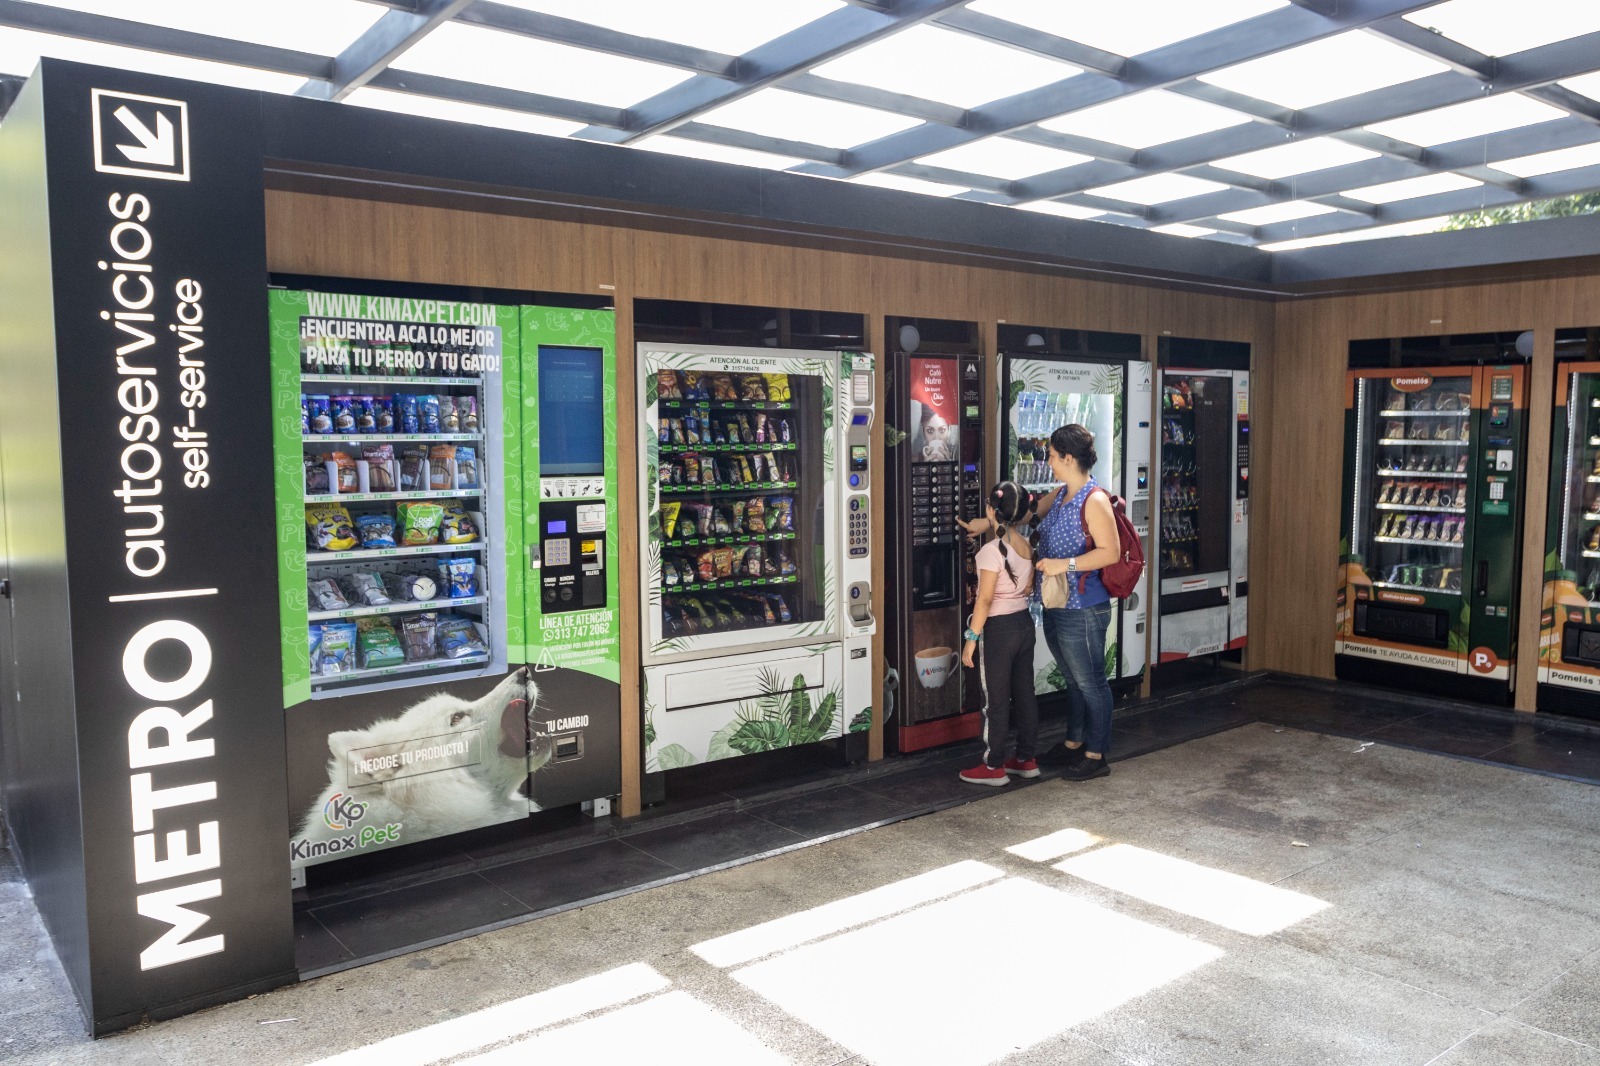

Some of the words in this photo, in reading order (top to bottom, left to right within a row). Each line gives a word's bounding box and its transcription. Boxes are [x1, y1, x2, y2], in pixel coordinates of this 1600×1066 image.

[306, 291, 496, 326] WWW.KIMAXPET.COM
[301, 319, 395, 342] ¡ENCUENTRA
[399, 325, 429, 344] ACA
[430, 327, 447, 345] LO
[450, 328, 494, 347] MEJOR
[306, 346, 350, 366] PARA
[352, 348, 372, 367] TU
[375, 349, 425, 369] PERRO
[427, 351, 438, 370] Y
[440, 352, 458, 370] TU
[461, 353, 500, 372] GATO!
[710, 356, 741, 364] ATENCIÓN
[98, 192, 166, 577] autoservicios
[170, 278, 210, 489] self-service
[924, 377, 942, 385] Nutre
[1396, 376, 1429, 385] Pomelós
[539, 616, 563, 630] LÍNEA
[564, 616, 575, 626] DE
[576, 610, 613, 625] ATENCIÓN
[555, 628, 570, 640] 313
[572, 626, 588, 637] 747
[589, 622, 610, 635] 2062
[1345, 643, 1377, 654] Pomelós
[1389, 651, 1413, 660] AYUDA
[1420, 655, 1456, 667] CUIDARTE
[1552, 671, 1594, 684] Pomelós
[546, 719, 556, 733] TU
[556, 714, 589, 731] CAMBIO
[360, 754, 399, 774] RECOGE
[400, 751, 413, 765] TU
[415, 741, 464, 763] PRODUCTO
[123, 620, 225, 971] METRO
[290, 836, 356, 861] Kimax
[360, 824, 402, 848] Pet
